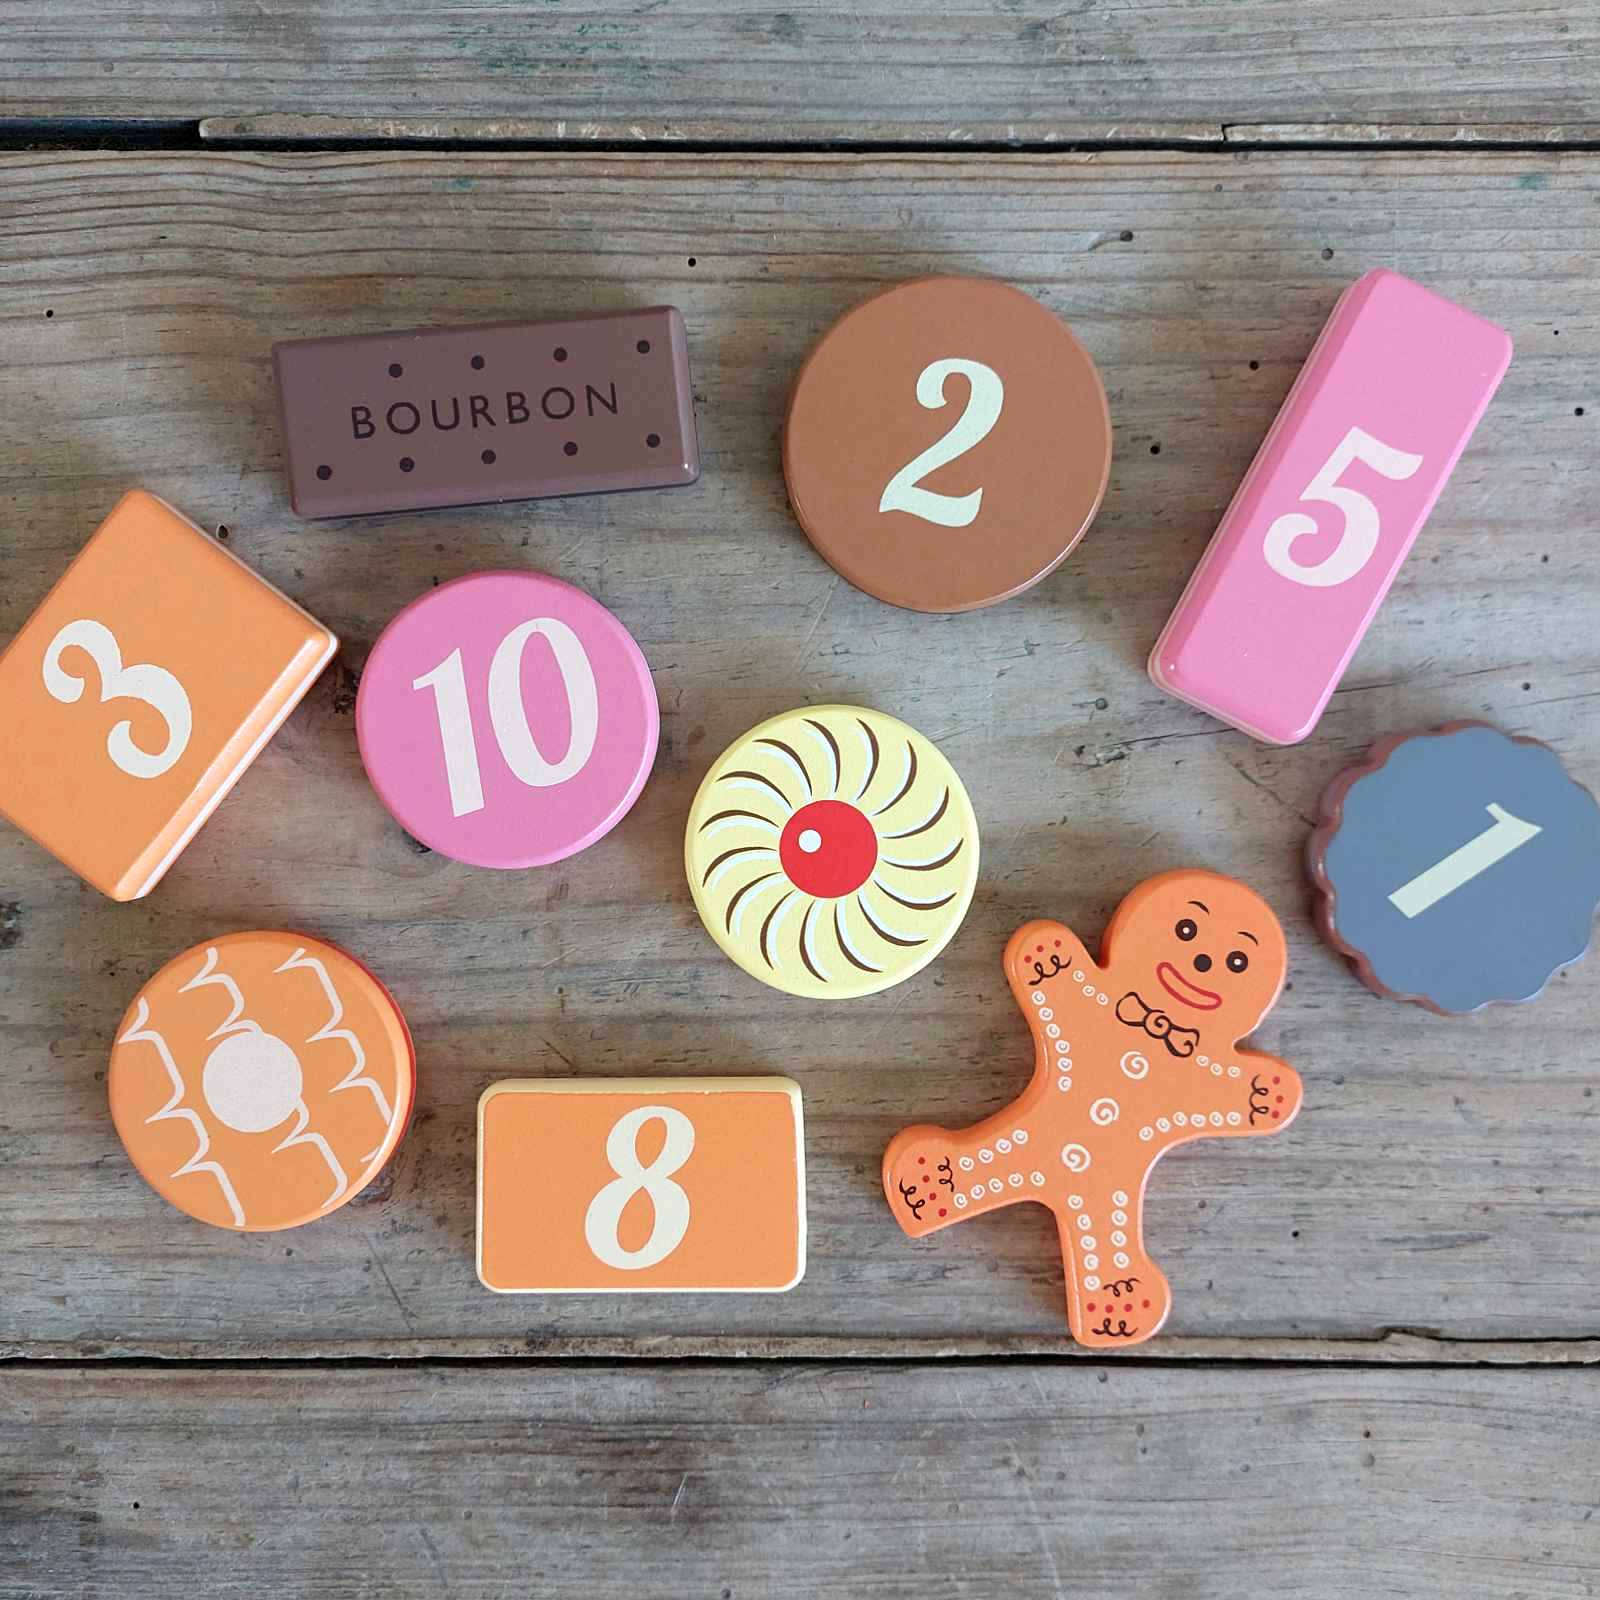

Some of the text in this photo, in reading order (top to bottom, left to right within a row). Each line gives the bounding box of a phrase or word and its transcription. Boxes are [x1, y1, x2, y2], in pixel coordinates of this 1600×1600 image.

[352, 383, 618, 440] BOURBON
[879, 358, 1004, 528] 2
[1263, 427, 1423, 587] 5
[43, 619, 193, 779] 3
[412, 617, 599, 818] 10
[1388, 803, 1542, 919] 1
[585, 1106, 696, 1270] 8
